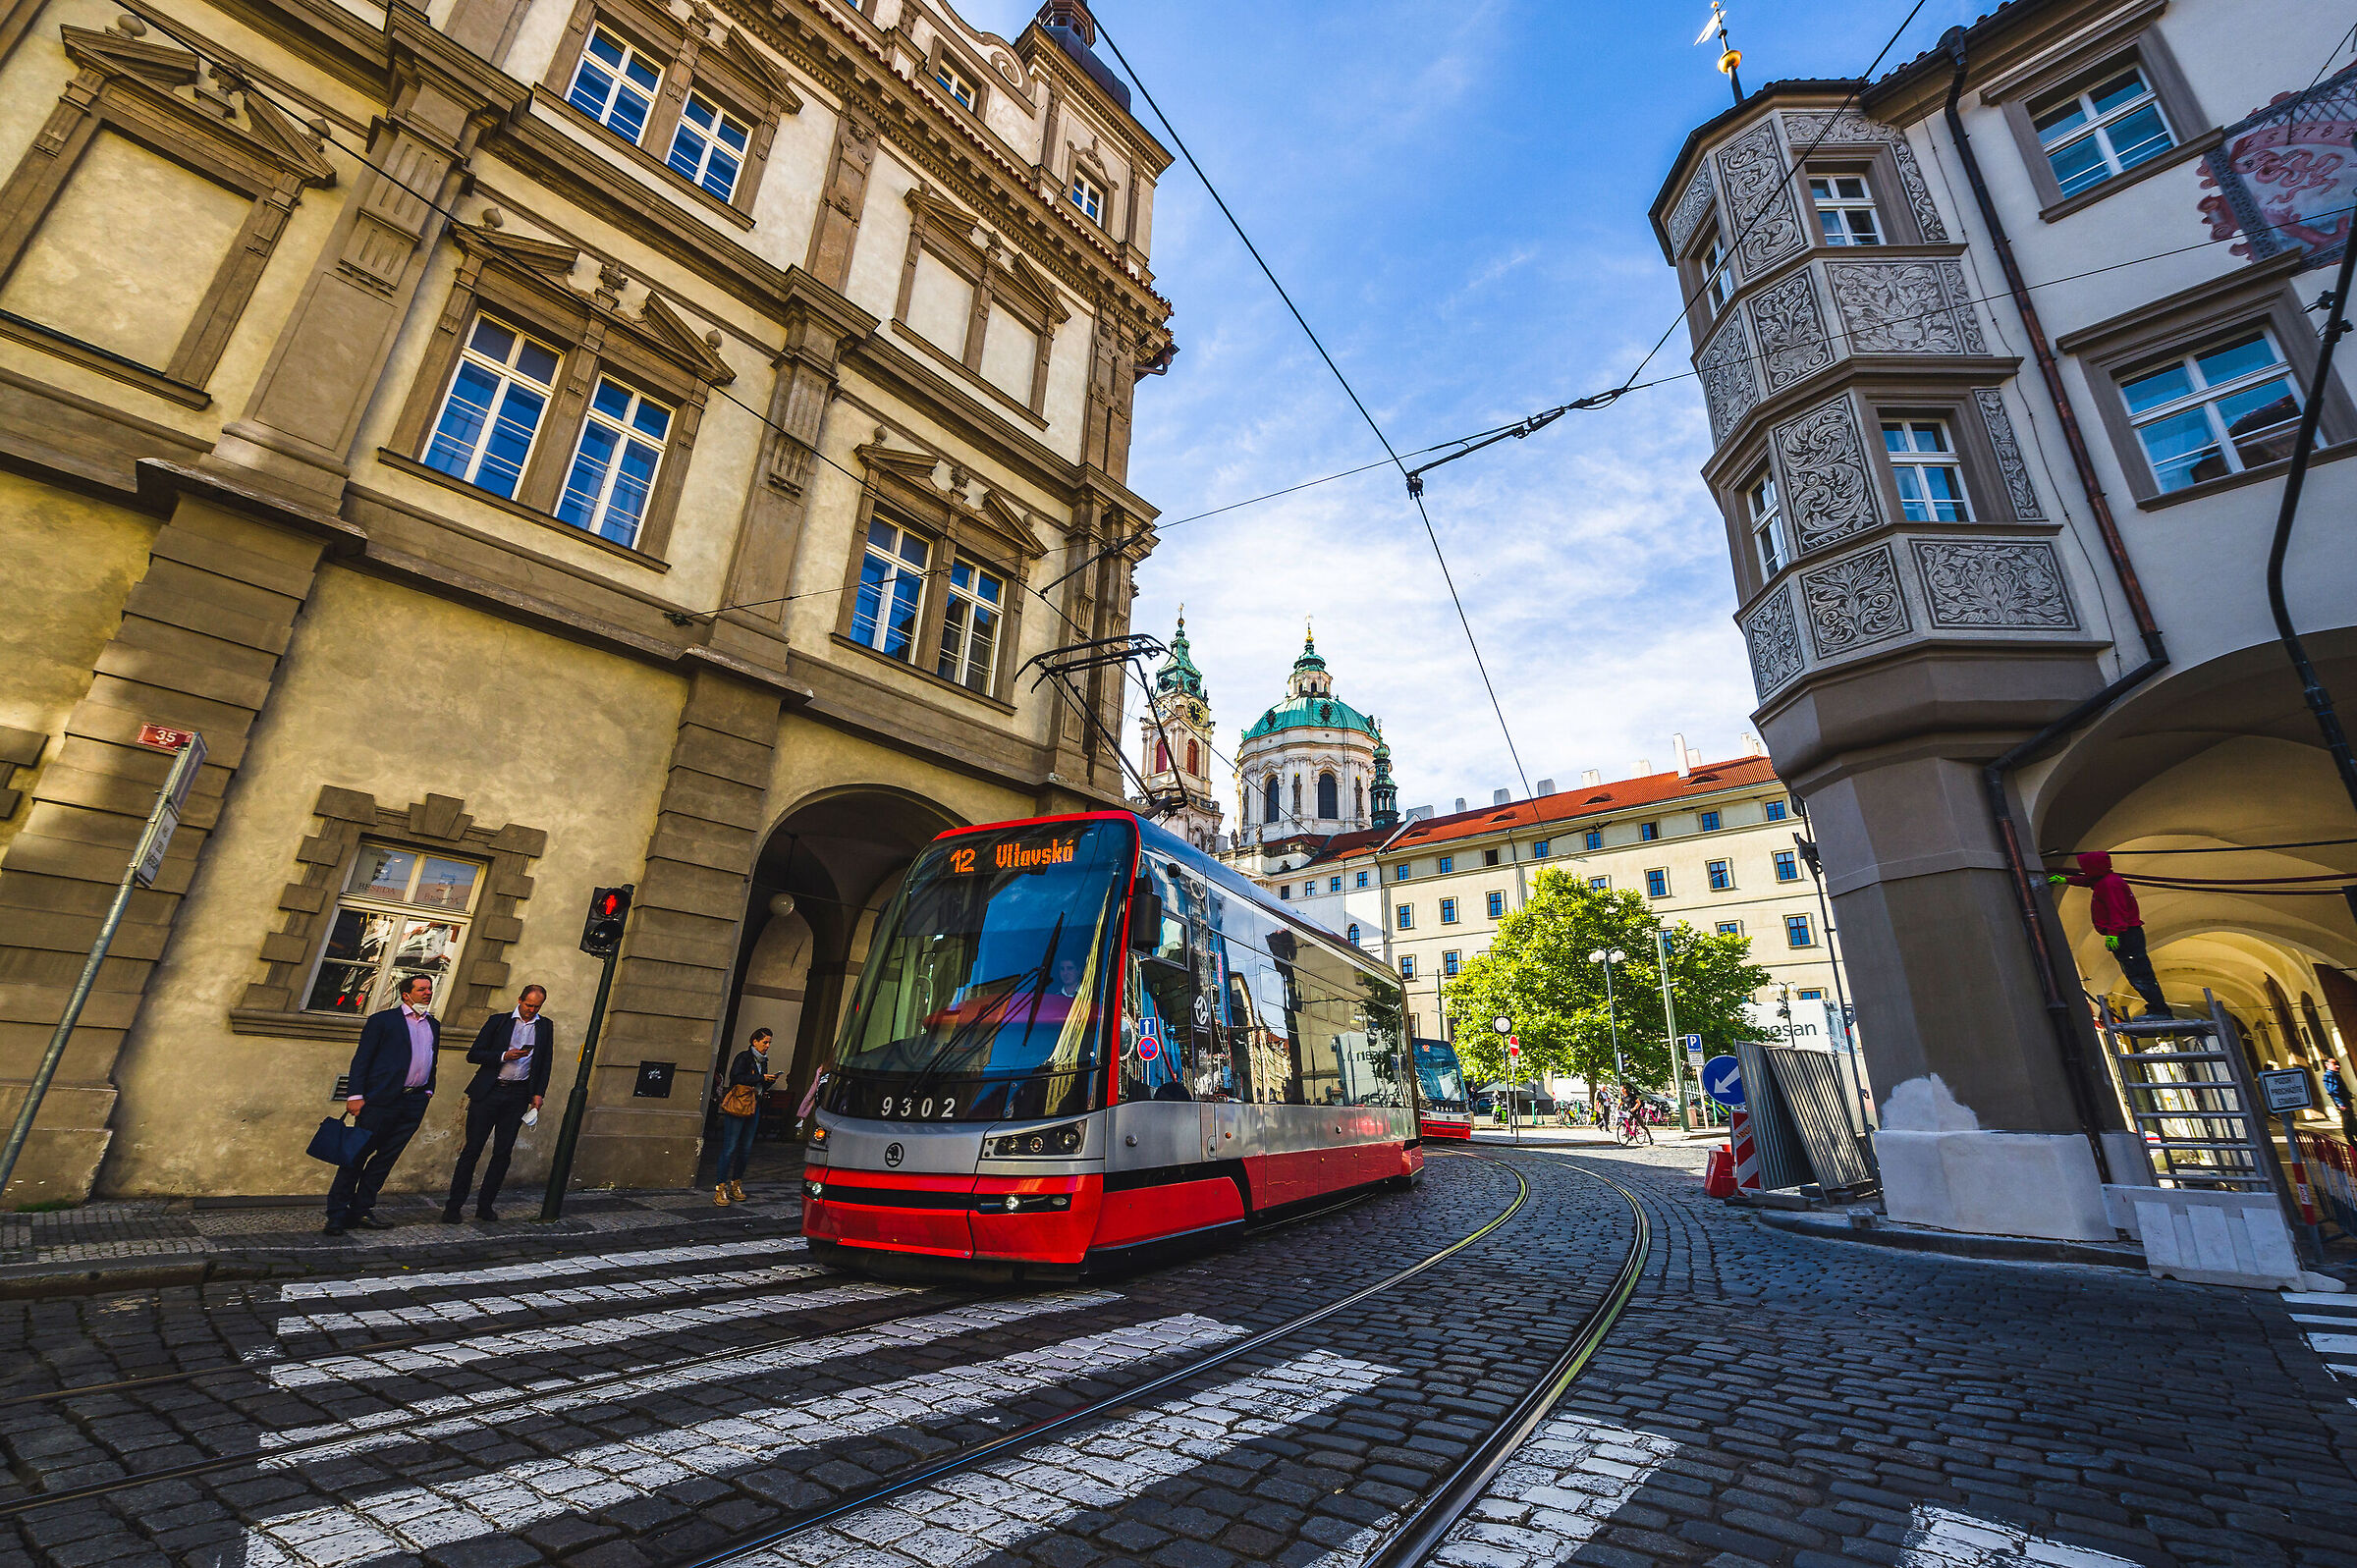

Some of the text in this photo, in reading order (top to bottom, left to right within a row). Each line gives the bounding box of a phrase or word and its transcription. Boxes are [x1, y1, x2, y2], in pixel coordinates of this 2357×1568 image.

[2321, 125, 2333, 137] 8
[155, 730, 177, 743] 35
[950, 838, 1074, 873] 12 Vltavská
[1689, 1036, 1697, 1047] P
[881, 1096, 956, 1117] 9302
